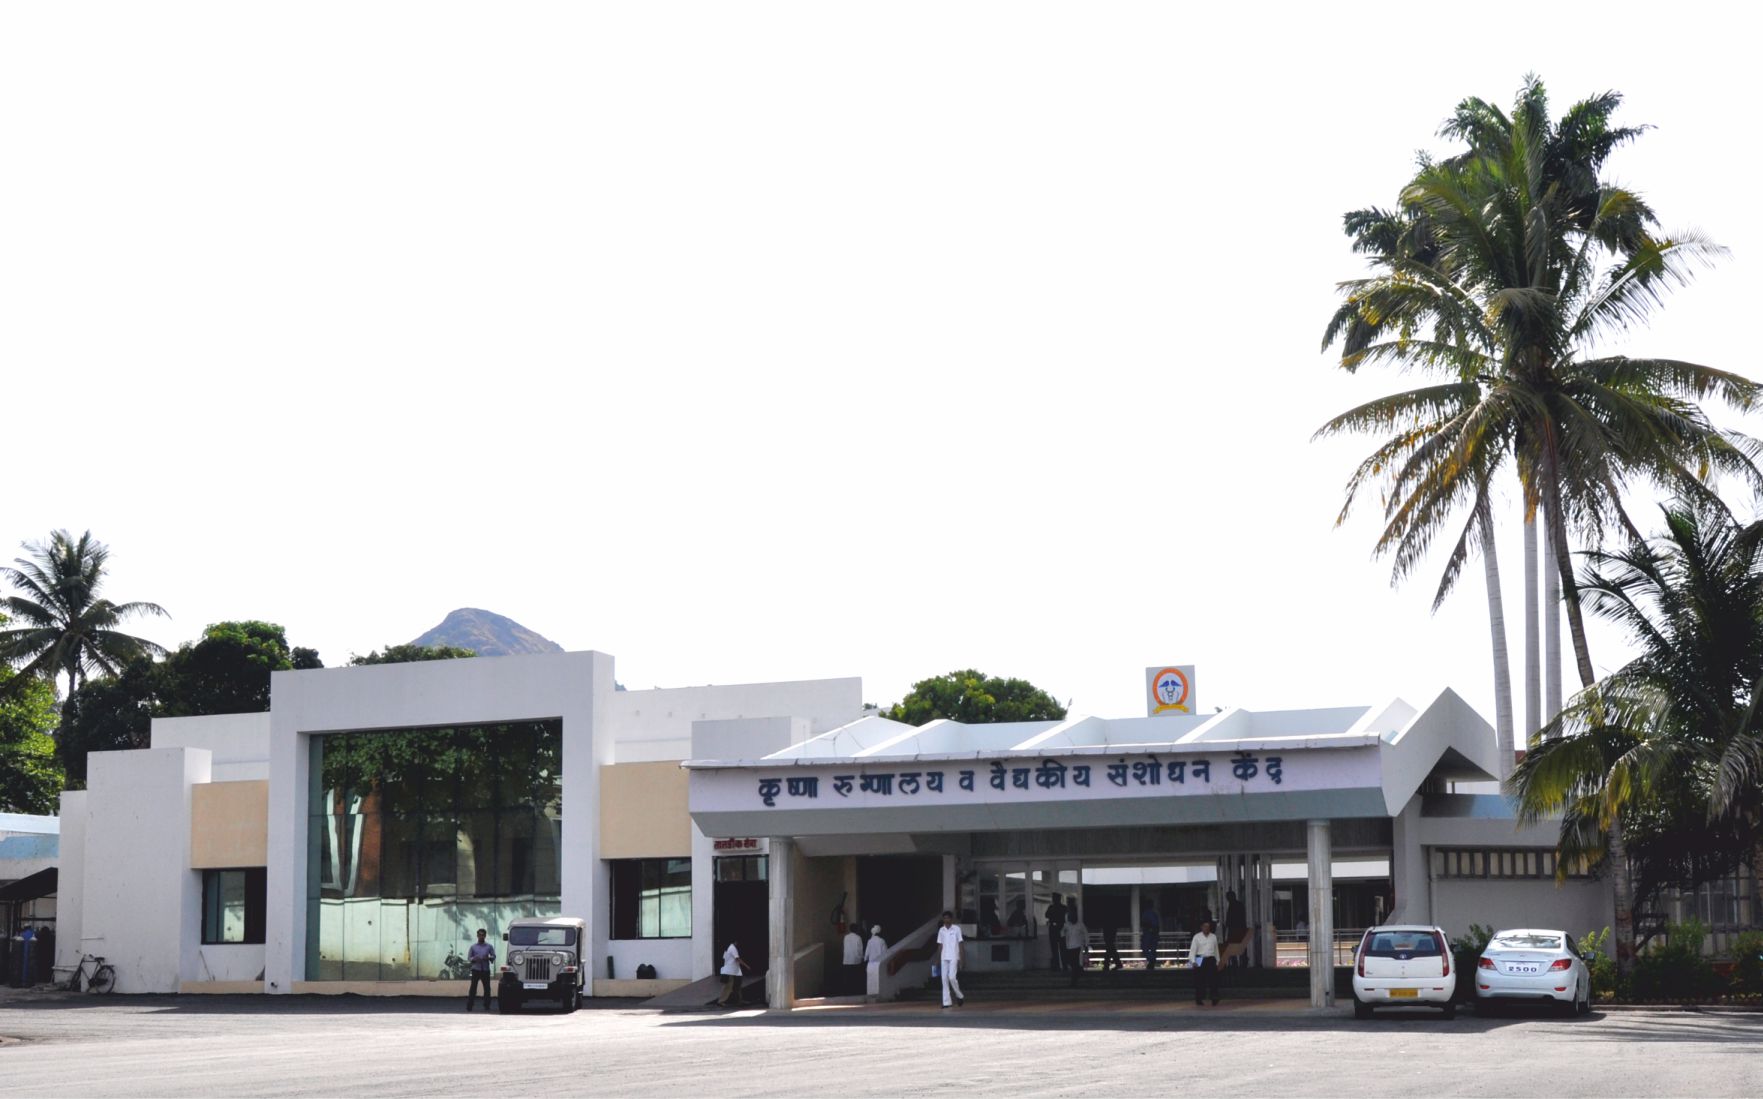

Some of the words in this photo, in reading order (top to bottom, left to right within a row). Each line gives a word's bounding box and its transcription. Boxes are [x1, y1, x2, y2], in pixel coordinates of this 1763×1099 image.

[758, 776, 819, 807] कृष्णा
[958, 769, 976, 792] व
[989, 758, 1092, 791] वैद्यकीय
[1106, 754, 1212, 788] संशोधन
[1230, 749, 1284, 785] केंद्र
